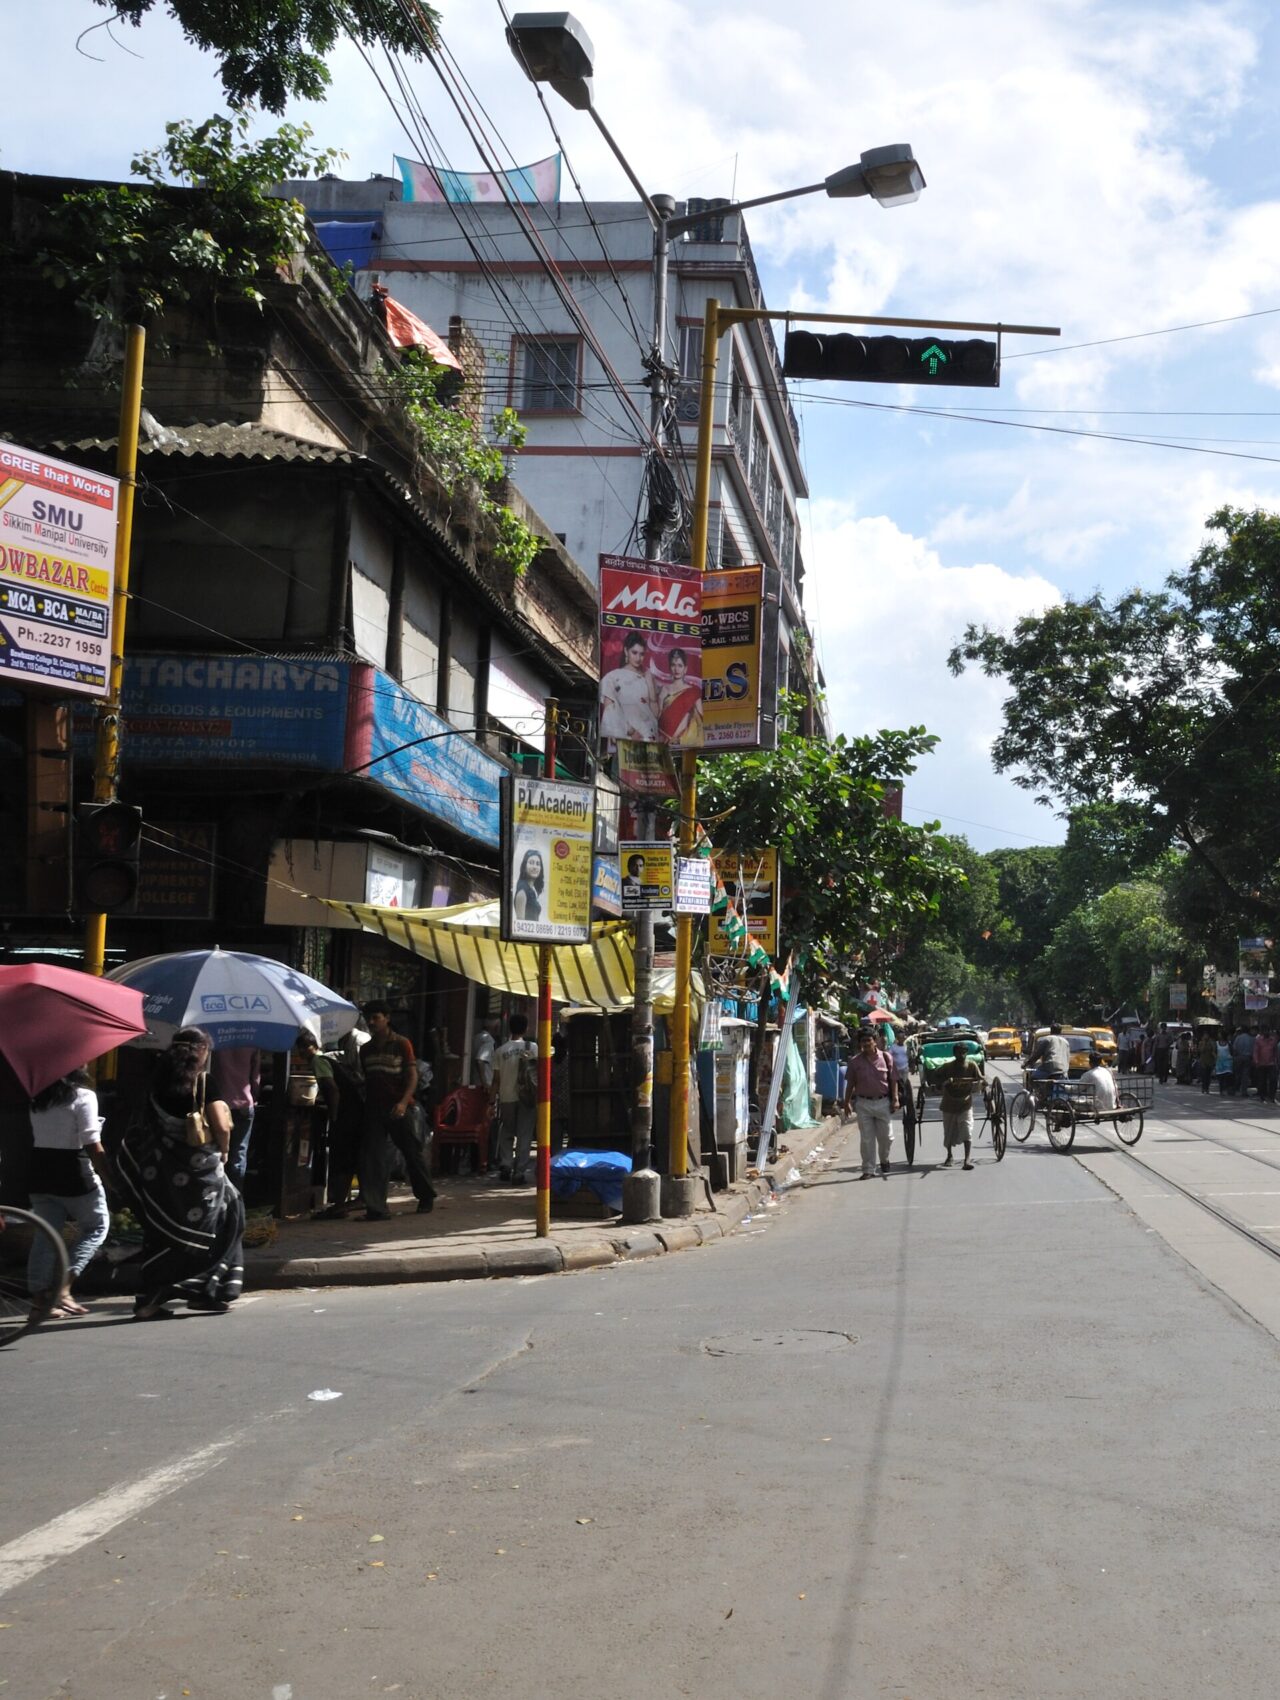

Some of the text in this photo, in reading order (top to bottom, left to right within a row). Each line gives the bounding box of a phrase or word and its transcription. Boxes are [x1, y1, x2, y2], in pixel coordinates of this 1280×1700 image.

[44, 467, 69, 485] that
[72, 476, 111, 498] Works
[32, 500, 83, 531] SMU
[3, 513, 32, 533] Sikkim
[35, 523, 67, 545] Manipal
[69, 533, 109, 558] University
[8, 590, 103, 621] MCA BCA MA/BA
[606, 580, 699, 618] Mala
[606, 615, 701, 635] SAREES
[718, 611, 749, 625] WBCS
[18, 626, 71, 649] Ph.:2237
[76, 641, 102, 656] 1959
[711, 637, 727, 645] RAIL
[731, 635, 750, 643] BANK
[148, 704, 205, 716] GOODS
[208, 706, 220, 716] &
[224, 706, 324, 719] EQUIPMENTS
[518, 788, 589, 822] P.L.Academy
[228, 996, 269, 1010] CIA
